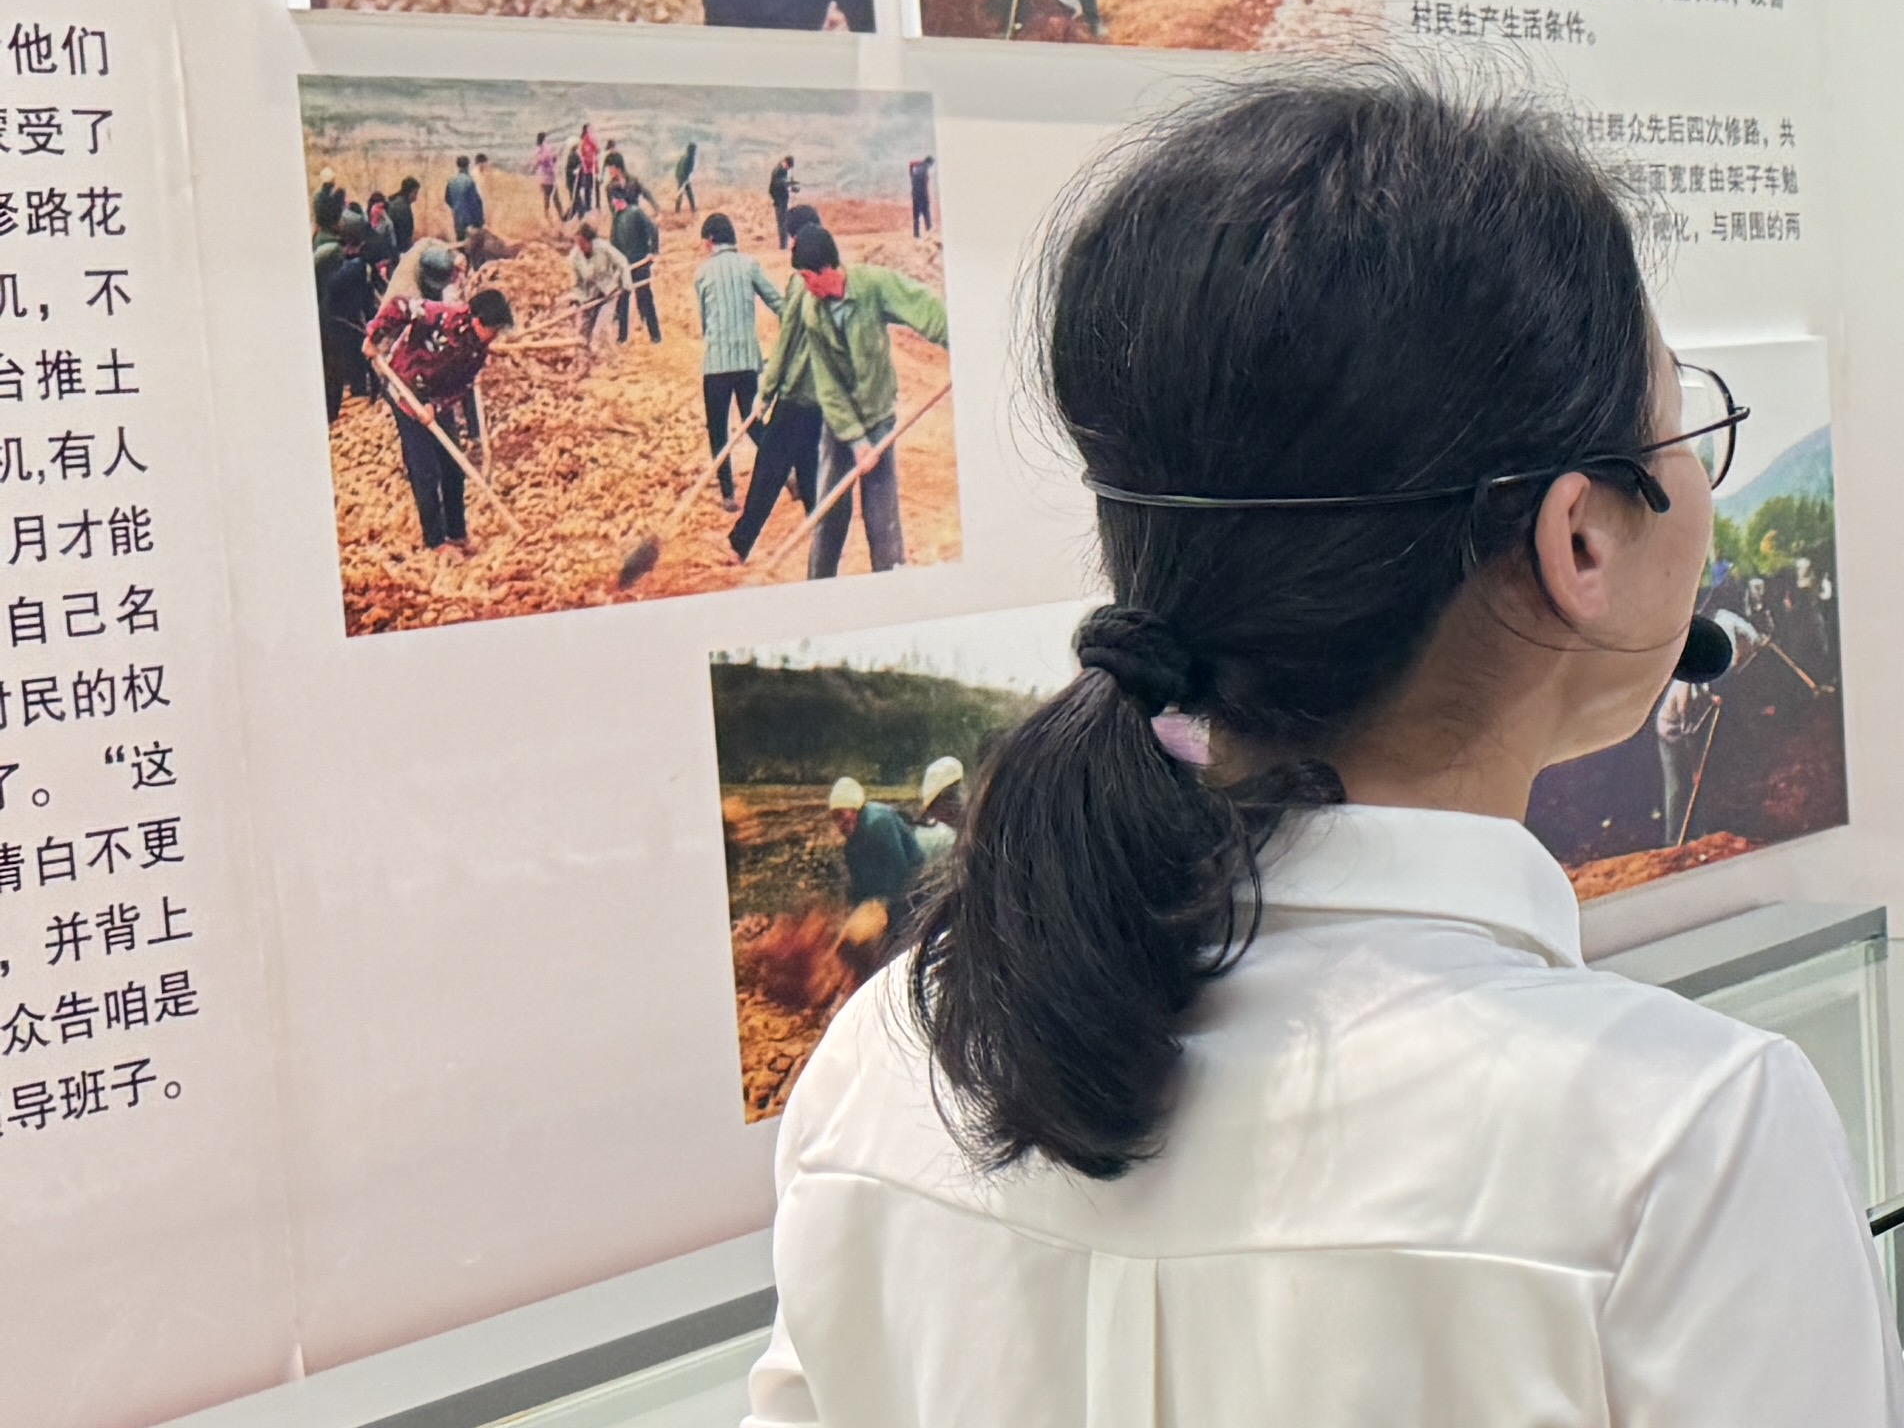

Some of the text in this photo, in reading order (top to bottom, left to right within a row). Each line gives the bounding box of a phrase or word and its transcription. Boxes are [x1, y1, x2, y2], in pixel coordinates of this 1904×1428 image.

[1570, 111, 1796, 148] 村群众先后四次修路，共
[8, 504, 154, 566] 月才能
[8, 584, 159, 648] 自己名
[0, 969, 200, 1057] 众告咱是
